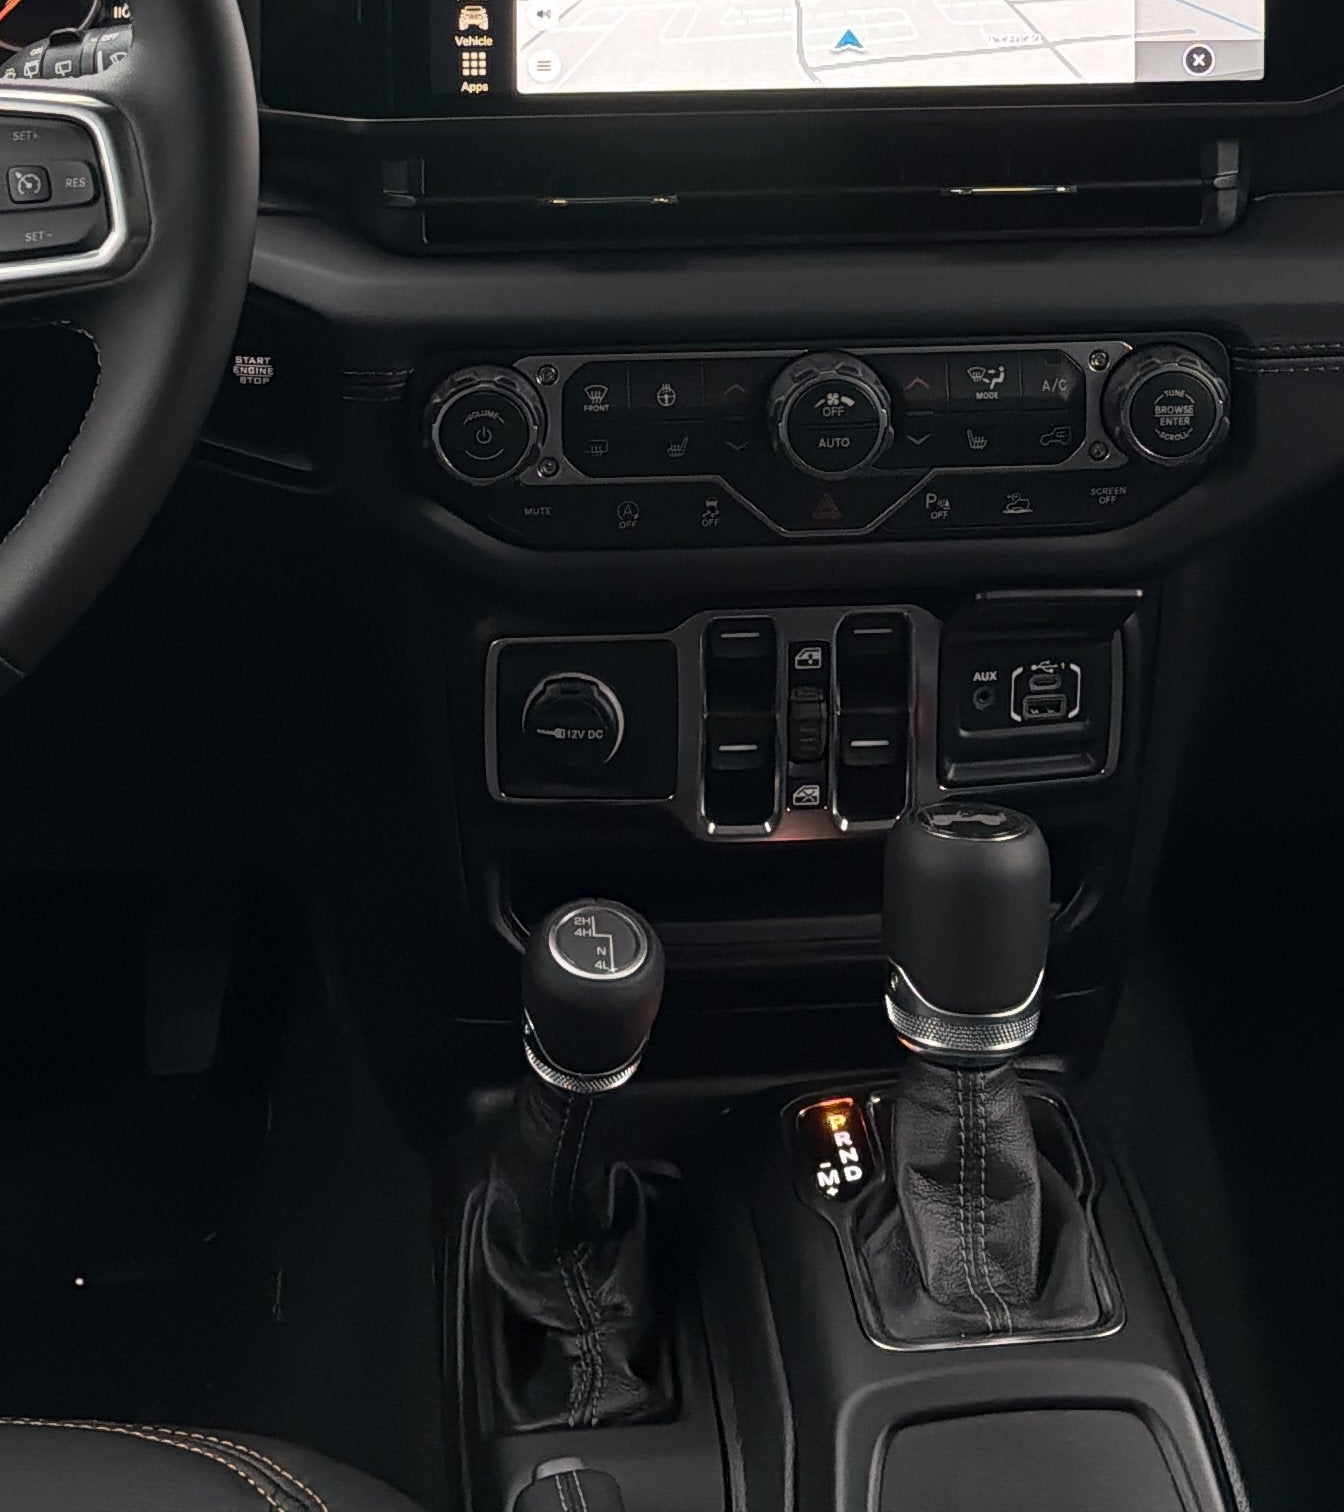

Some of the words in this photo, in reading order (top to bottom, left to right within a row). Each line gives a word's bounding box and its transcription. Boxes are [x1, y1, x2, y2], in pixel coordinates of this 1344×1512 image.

[454, 35, 493, 47] Vehicle
[460, 81, 489, 94] Apps
[65, 177, 86, 189] RES
[234, 355, 271, 365] START
[232, 365, 274, 376] ENGINE
[239, 376, 270, 385] STOP
[1041, 379, 1068, 392] A/C
[975, 391, 1000, 400] MODE
[1164, 389, 1186, 399] TUNE
[583, 403, 610, 413] FRONT
[822, 405, 844, 417] OFF
[1154, 404, 1194, 415] BROWSE
[467, 409, 501, 422] VOLUME
[1159, 416, 1191, 427] ENTER
[1159, 430, 1190, 442] SCROLL
[818, 436, 851, 450] AUTO
[1090, 486, 1127, 497] SCREEN
[1098, 495, 1117, 505] OFF
[524, 506, 552, 516] MUTE
[930, 510, 949, 520] OFF
[618, 520, 638, 530] OFF
[701, 518, 720, 528] OFF
[972, 670, 998, 683] AUX
[565, 728, 588, 740] 12V
[590, 728, 604, 740] DC
[573, 916, 592, 926] 2H
[573, 927, 593, 937] 4H
[596, 946, 607, 956] N
[594, 960, 611, 971] 4L
[828, 1114, 847, 1131] P
[833, 1131, 854, 1148] R
[838, 1146, 859, 1165] N
[816, 1167, 841, 1188] M
[843, 1165, 863, 1182] D
